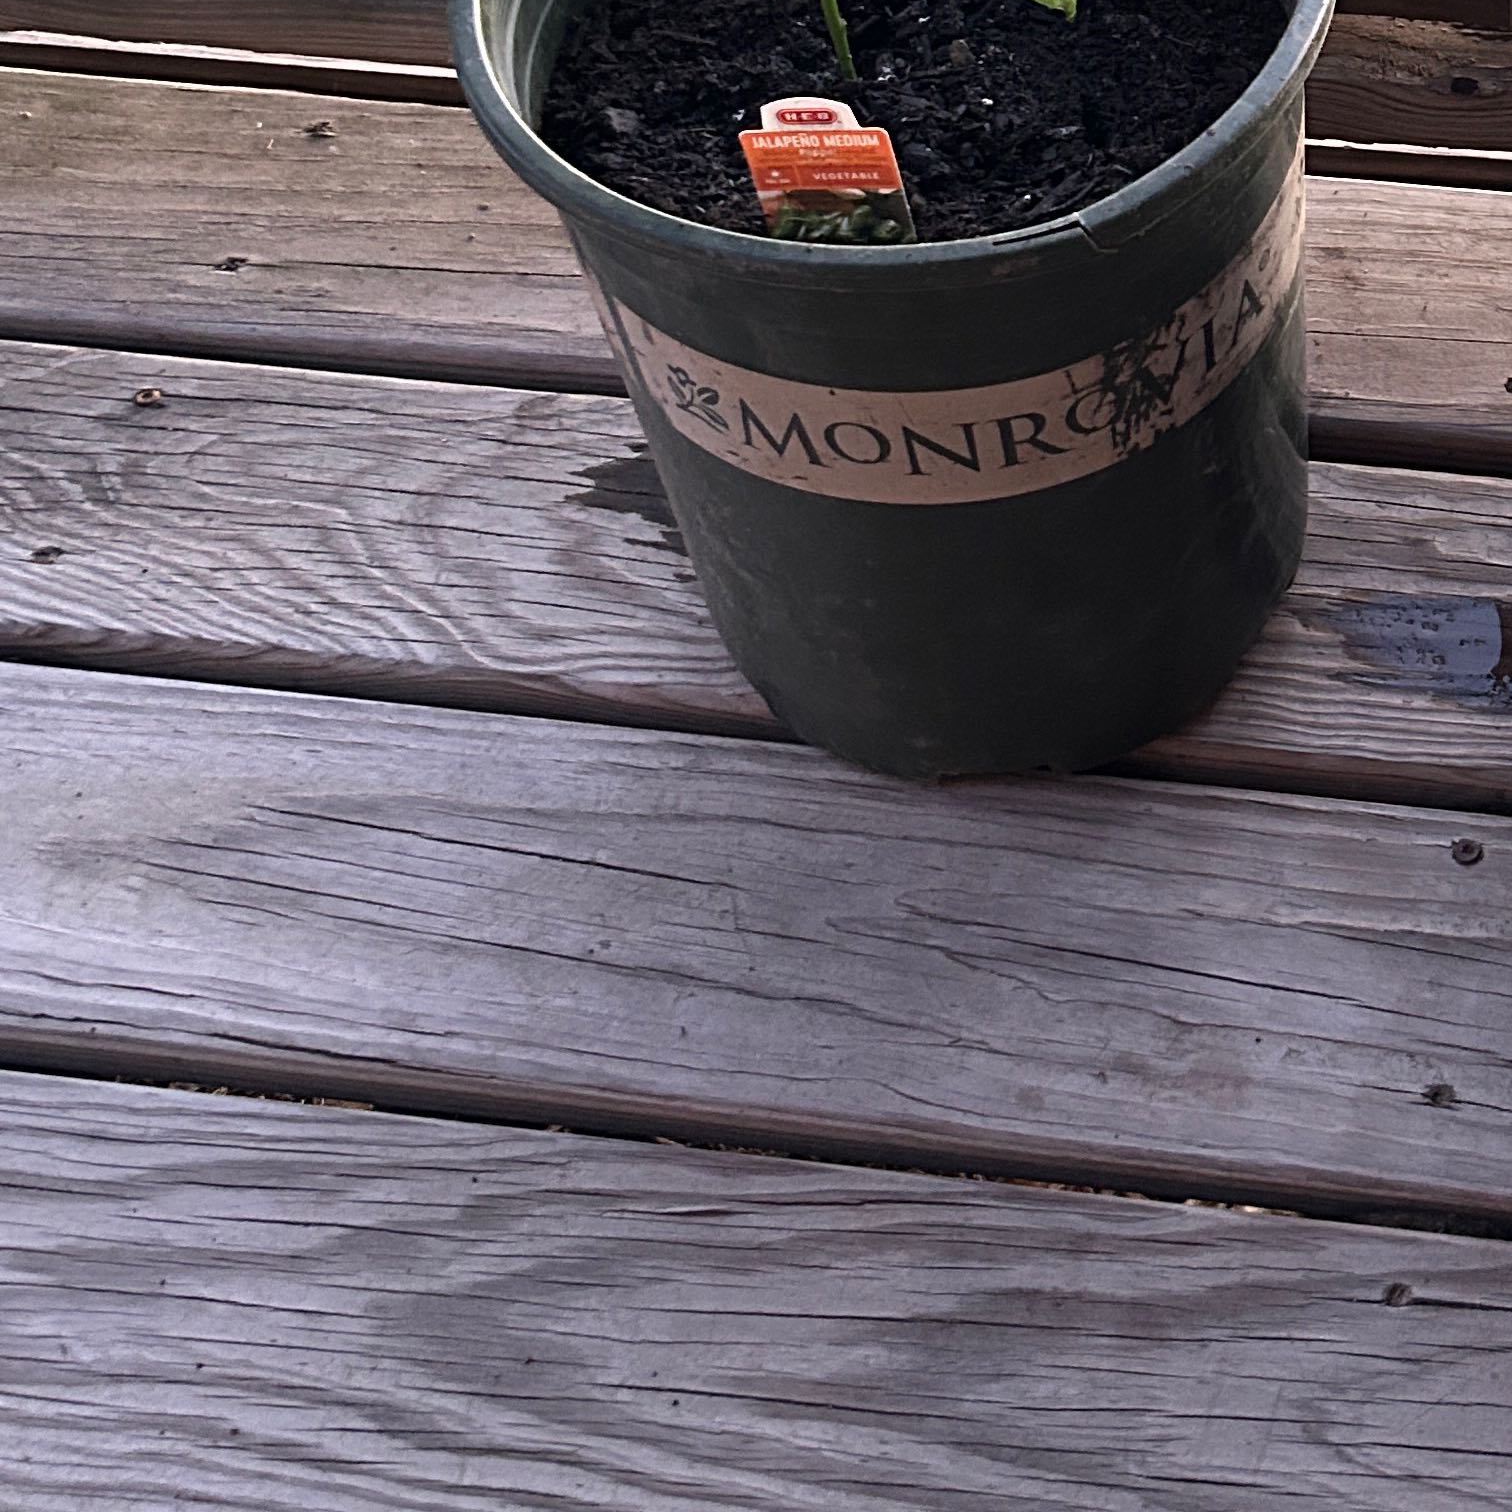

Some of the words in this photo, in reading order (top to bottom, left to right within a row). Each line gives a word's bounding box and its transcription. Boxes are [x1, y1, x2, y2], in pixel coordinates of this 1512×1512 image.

[752, 133, 820, 148] JALAPEÑO
[823, 135, 880, 147] MEDIUM
[812, 172, 880, 180] VEGETABLE
